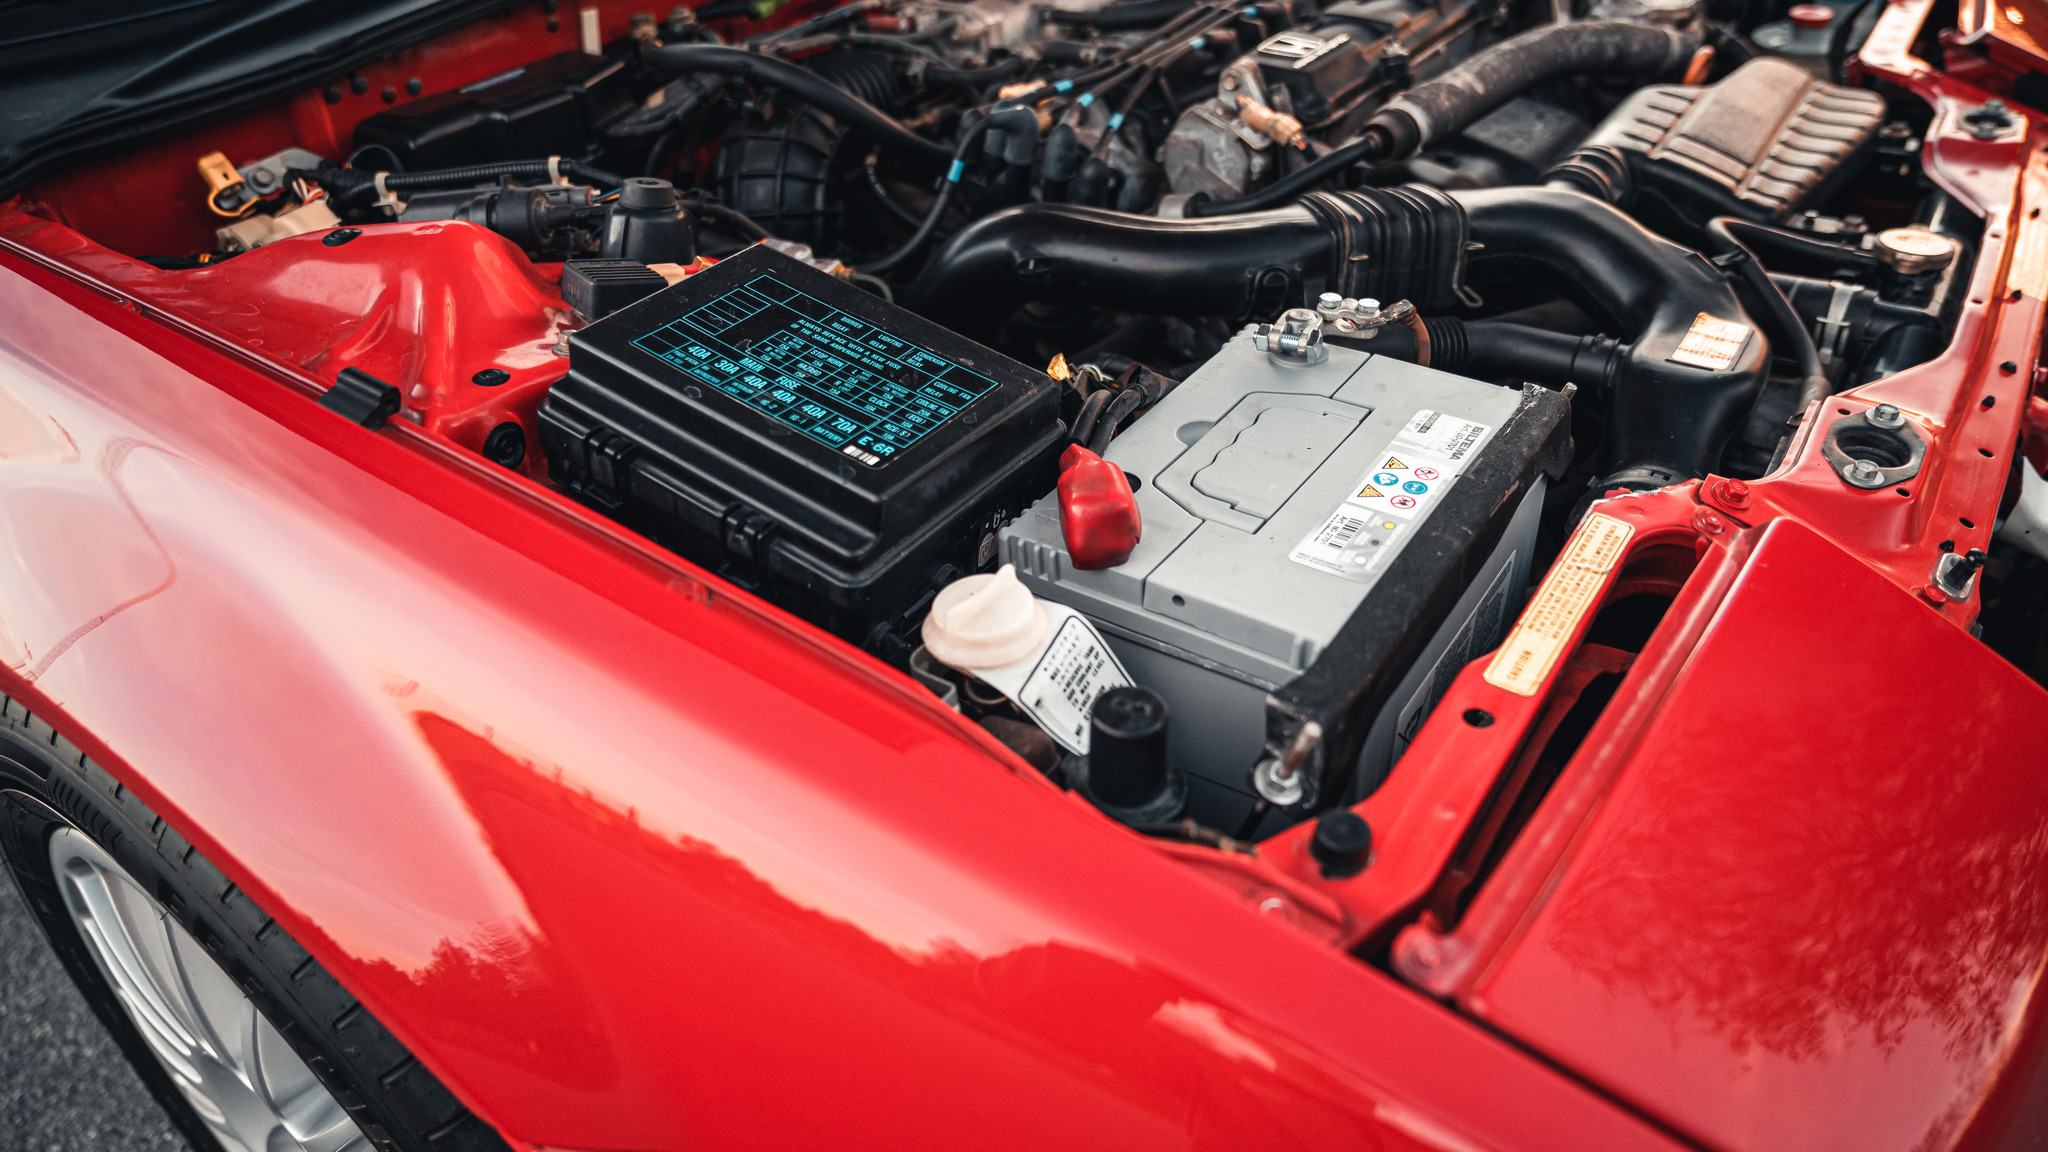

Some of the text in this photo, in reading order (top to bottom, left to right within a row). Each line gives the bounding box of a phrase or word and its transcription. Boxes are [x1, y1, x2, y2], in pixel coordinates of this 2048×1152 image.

[831, 322, 849, 332] RELAY
[798, 319, 822, 332] ALWAYS
[821, 330, 848, 344] REPLACE
[848, 342, 865, 353] WITH
[870, 354, 886, 362] NEW
[885, 360, 902, 370] FUSE
[812, 334, 830, 344] SAME
[830, 342, 861, 359] AMPERAGE
[869, 340, 887, 350] RELAY
[878, 334, 904, 348] LIGHTING
[688, 346, 712, 359] 40A
[912, 354, 923, 362] FAN
[714, 360, 740, 374] 30A
[797, 362, 822, 376] HAZARD
[906, 358, 923, 368] RELAY
[739, 357, 801, 390] MAIN FUSE
[743, 375, 768, 389] 40A
[772, 390, 796, 404] 40A
[924, 387, 943, 398] RELAY
[933, 381, 972, 400] COOLING FAN
[868, 396, 890, 408] CLOCK
[916, 398, 950, 416] COOLING FAN
[802, 404, 827, 419] 40A
[906, 413, 926, 424] (ECU)
[831, 417, 857, 434] 70A
[813, 426, 844, 442] BATTERY
[1449, 426, 1484, 460] BILTEMA
[1092, 659, 1105, 677] LEVEL
[1505, 650, 1533, 681] CAUTION
